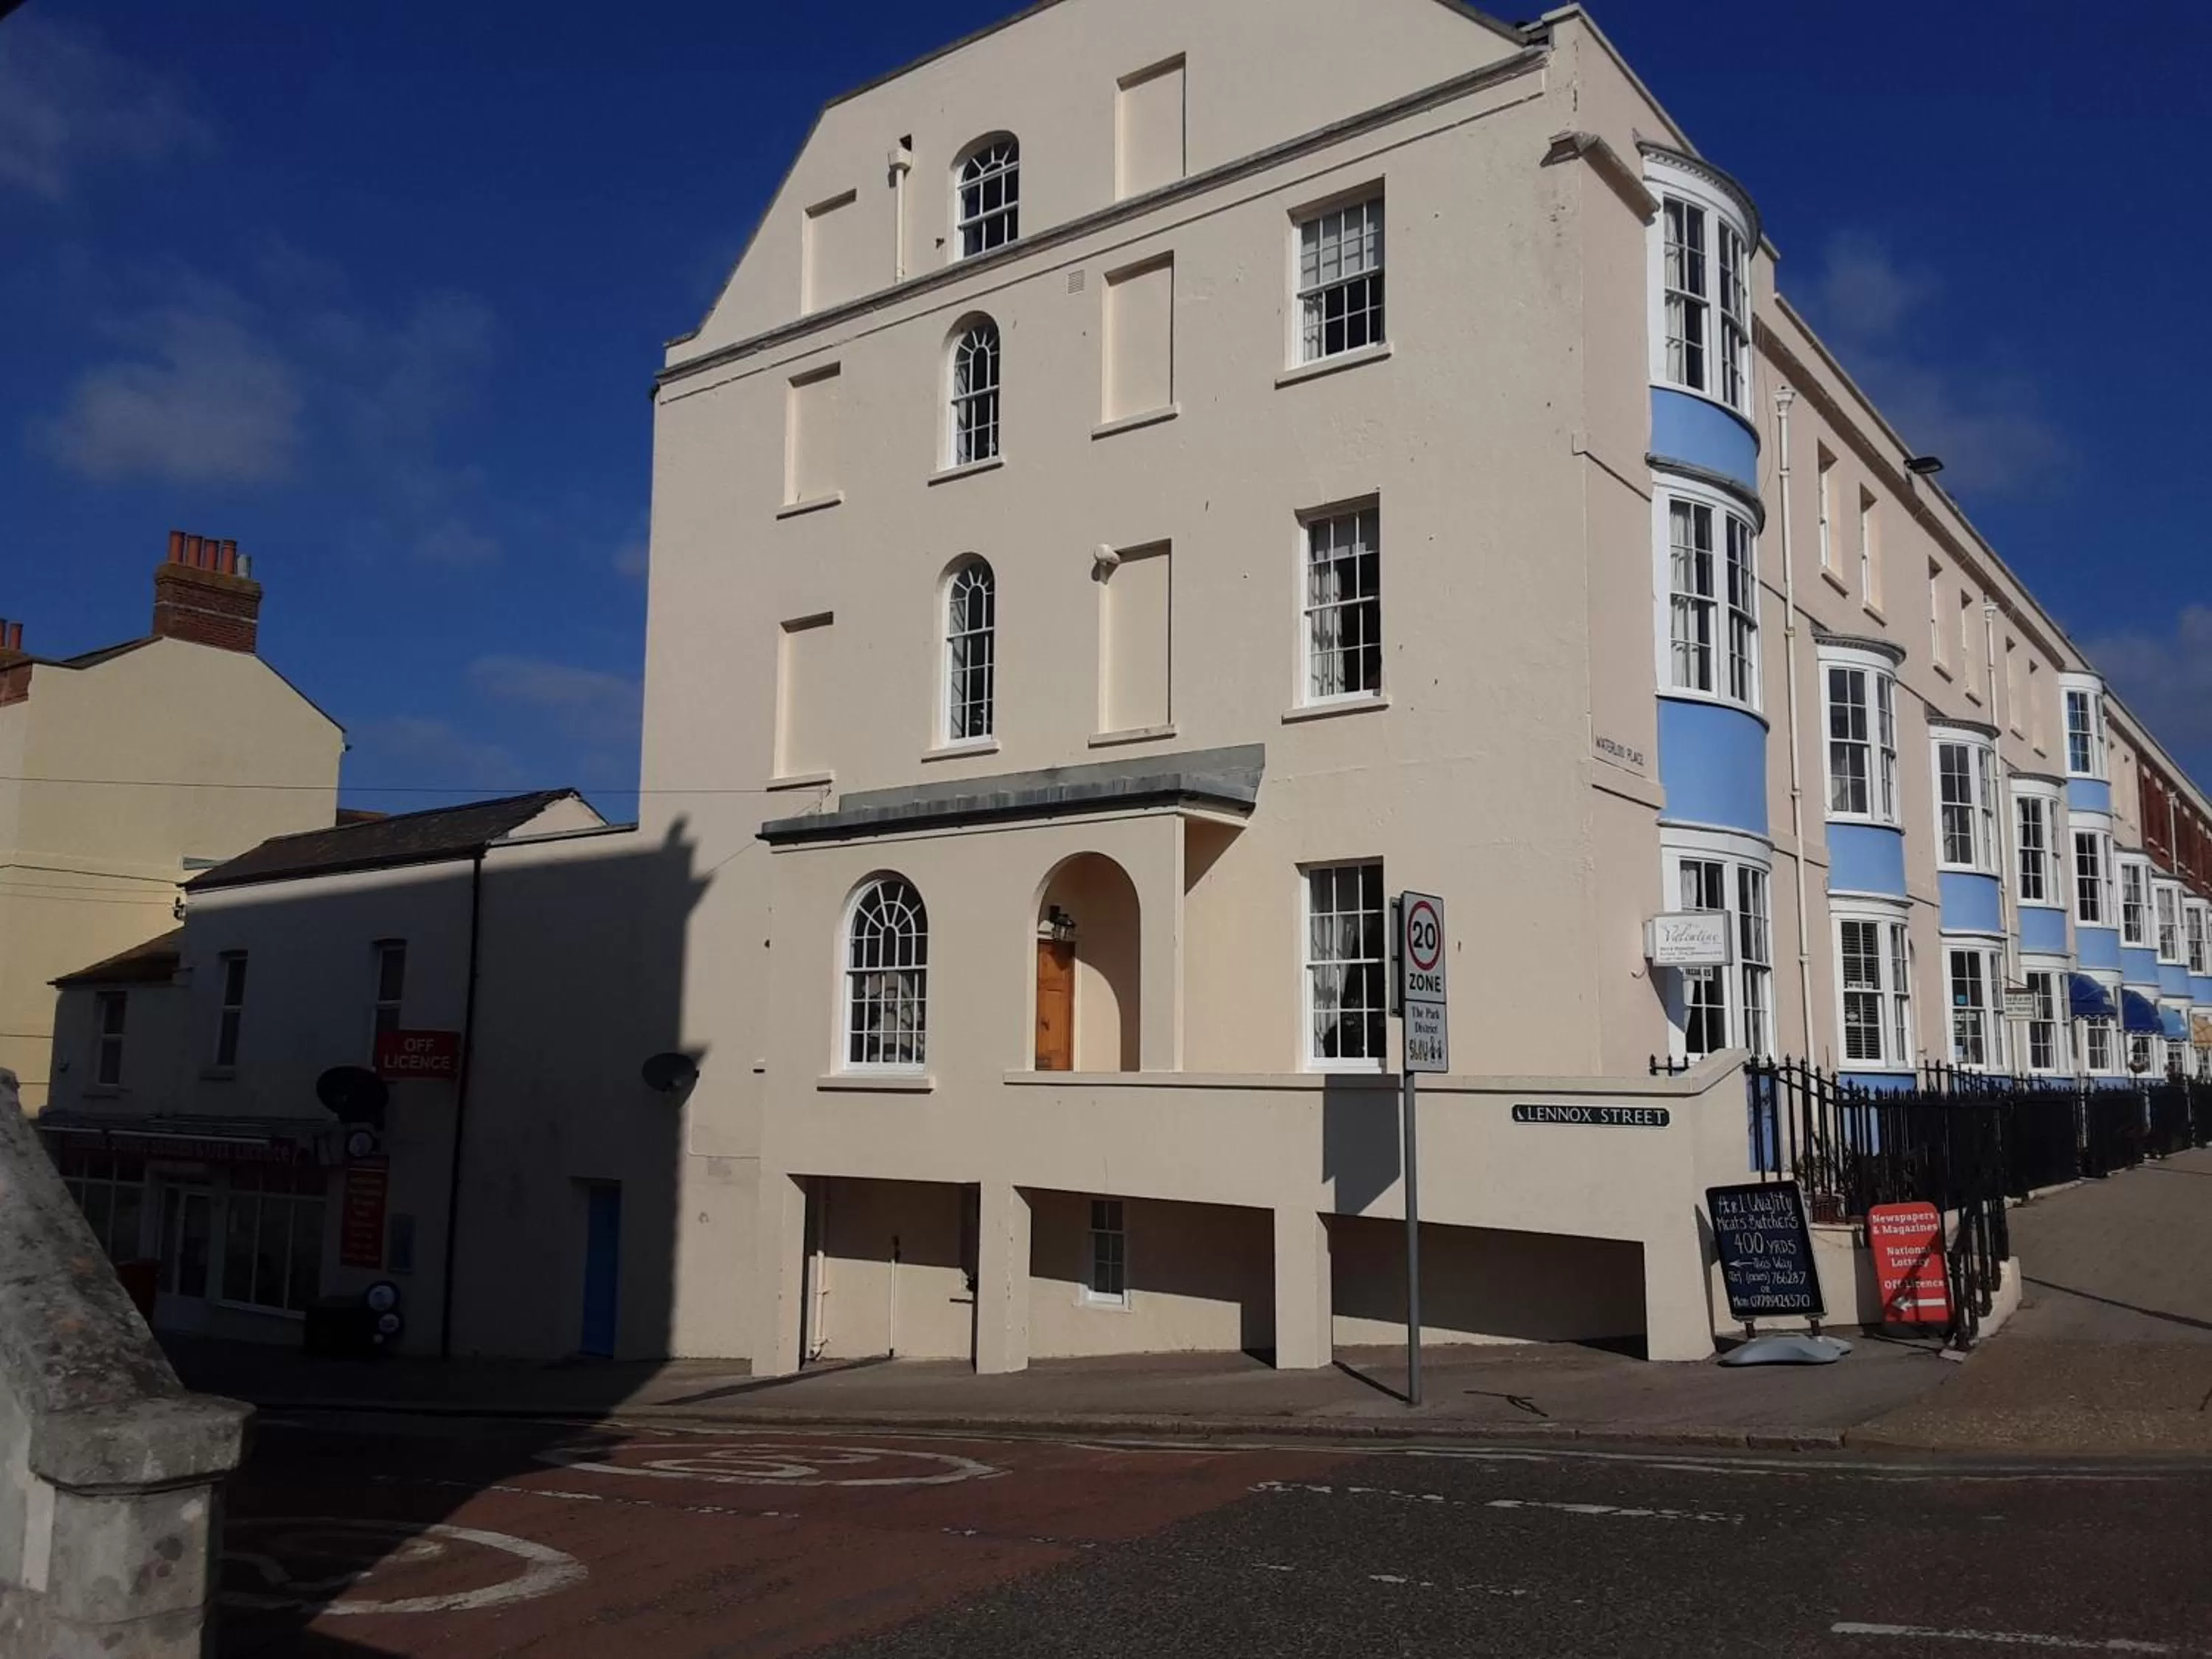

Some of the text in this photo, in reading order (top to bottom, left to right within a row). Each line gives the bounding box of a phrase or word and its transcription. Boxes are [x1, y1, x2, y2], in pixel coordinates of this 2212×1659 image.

[1413, 920, 1436, 950] 20
[1409, 973, 1441, 993] ZONE
[1411, 1006, 1440, 1020] The Park
[404, 1038, 434, 1052] OFF
[383, 1054, 451, 1070] LICENCE
[1527, 1107, 1665, 1124] LENNOX STREET
[1748, 1214, 1798, 1230] Butchers
[1872, 1212, 1935, 1223] Newspapers
[1872, 1223, 1938, 1235] & Magazines
[1734, 1232, 1764, 1254] 400
[1887, 1246, 1931, 1256] National
[1772, 1256, 1793, 1270] Way
[1891, 1257, 1930, 1268] Lottery
[1884, 1279, 1902, 1290] Off
